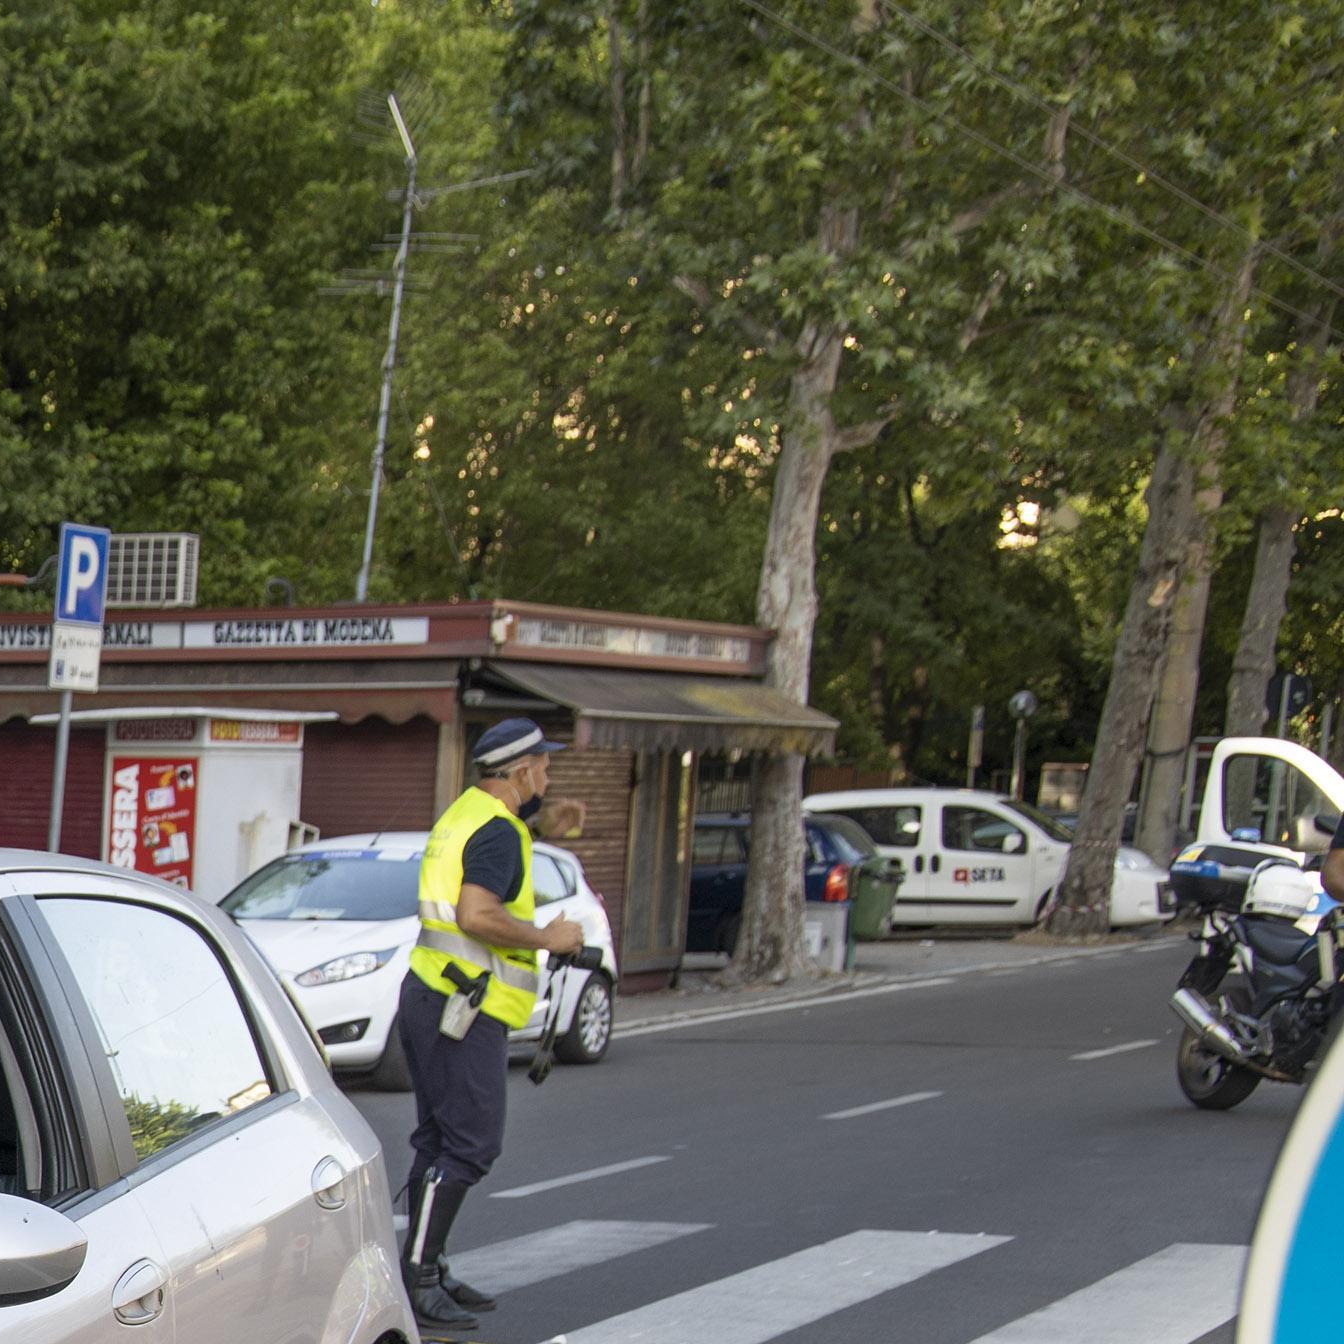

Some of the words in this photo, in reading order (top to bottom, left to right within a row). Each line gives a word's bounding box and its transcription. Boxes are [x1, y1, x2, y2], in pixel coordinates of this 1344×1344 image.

[66, 534, 99, 615] P
[103, 623, 154, 645] RNALI
[214, 620, 296, 643] GAZZETTA
[302, 620, 317, 642] DI
[324, 617, 395, 642] MODENA
[972, 867, 1006, 882] SETA
